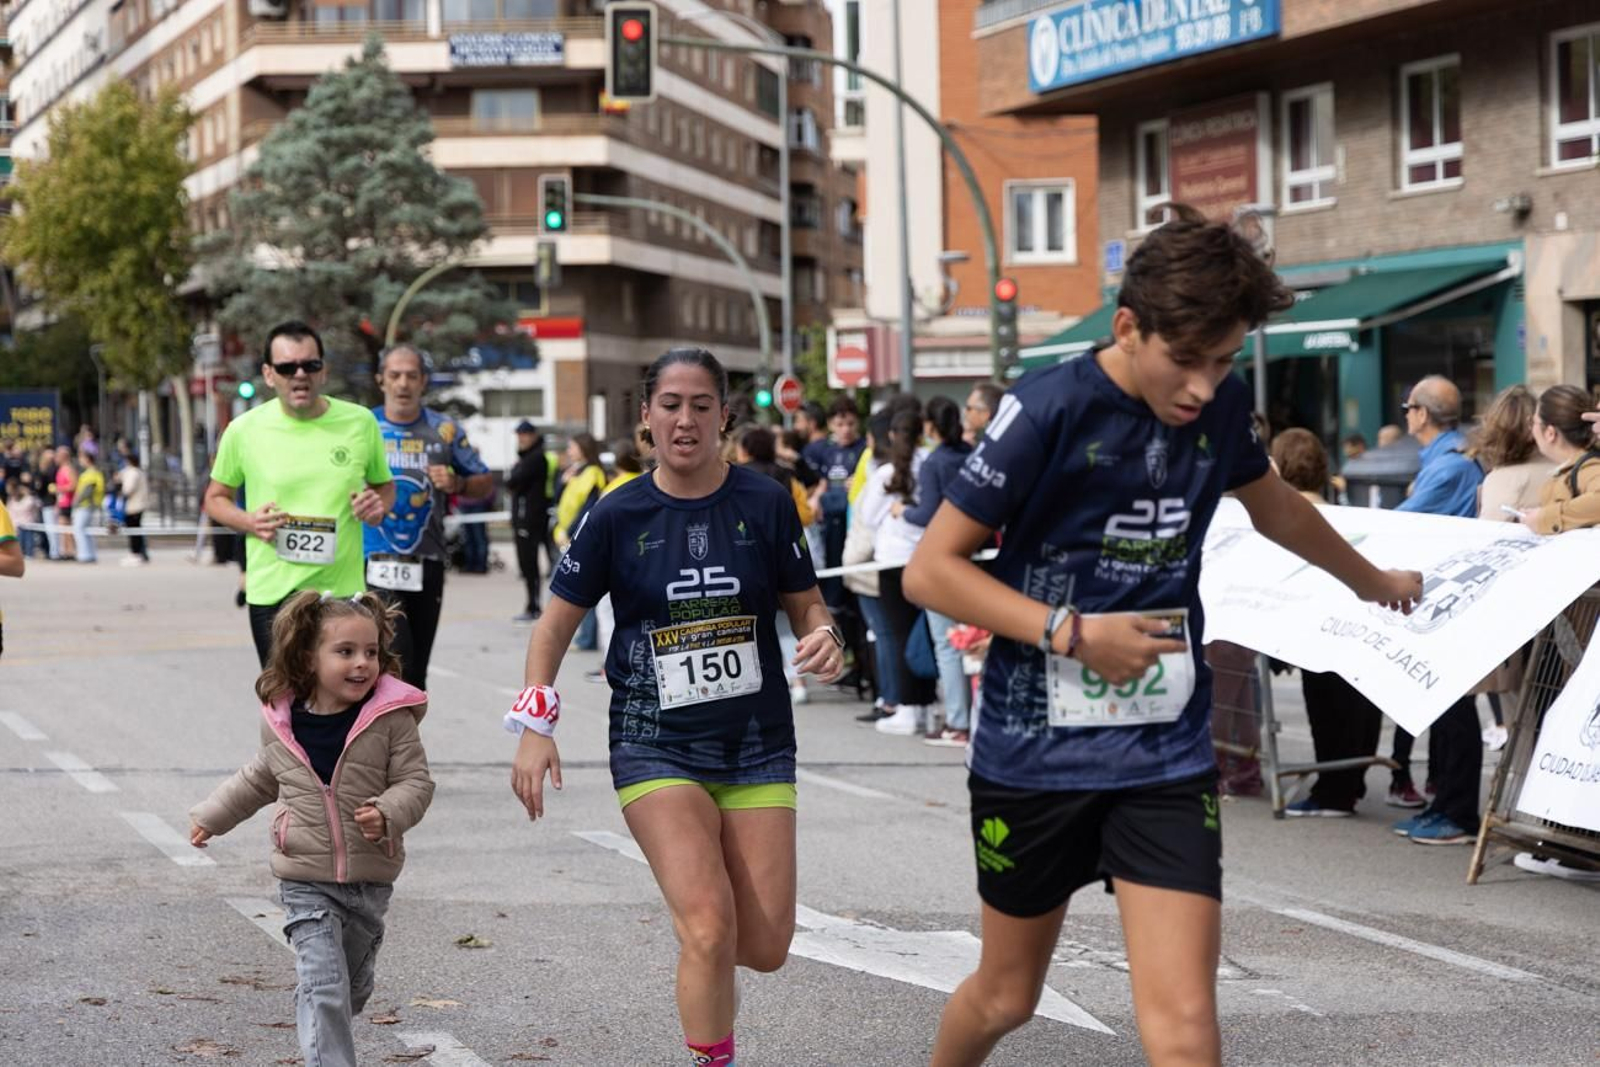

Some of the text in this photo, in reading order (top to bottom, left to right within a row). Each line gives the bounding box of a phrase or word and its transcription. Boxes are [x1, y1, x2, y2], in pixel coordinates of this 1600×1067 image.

[1059, 1, 1140, 54] CLÍNICA
[1105, 498, 1192, 540] 25
[286, 533, 325, 552] 622
[379, 565, 411, 581] 216
[666, 566, 741, 601] 25
[668, 596, 741, 612] CARRERA
[669, 605, 742, 622] POPULAR
[680, 623, 718, 636] CARRERA
[717, 619, 751, 631] POPULAR
[690, 631, 713, 643] gran
[716, 625, 751, 637] caminata
[655, 628, 680, 649] XXV
[679, 649, 742, 685] 150
[1363, 630, 1391, 651] DE
[1386, 648, 1440, 690] JAÉN
[1539, 752, 1585, 780] CIUDAD
